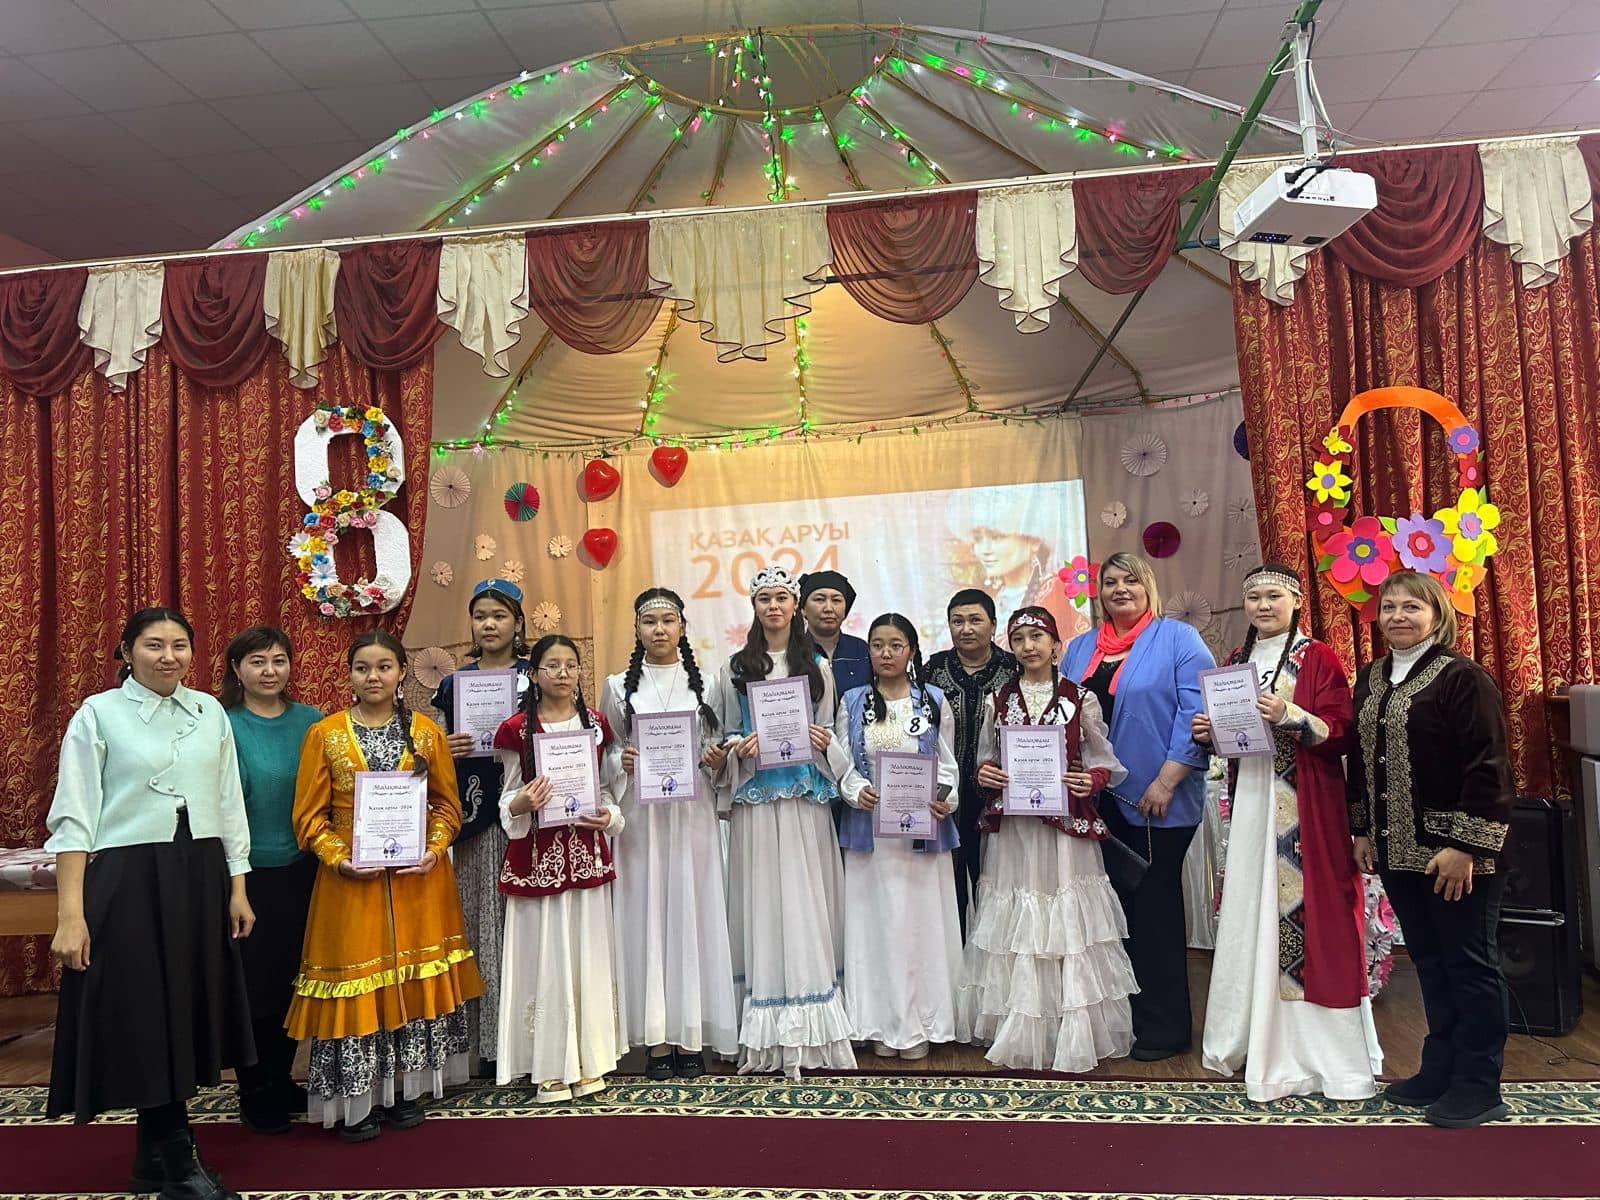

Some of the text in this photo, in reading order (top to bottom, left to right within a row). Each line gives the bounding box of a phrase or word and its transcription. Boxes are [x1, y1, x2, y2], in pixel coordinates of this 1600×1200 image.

[287, 402, 412, 616] 8
[690, 521, 849, 550] ҚАЗАҚ АРУЫ
[1259, 670, 1274, 686] 5
[909, 717, 921, 733] 8
